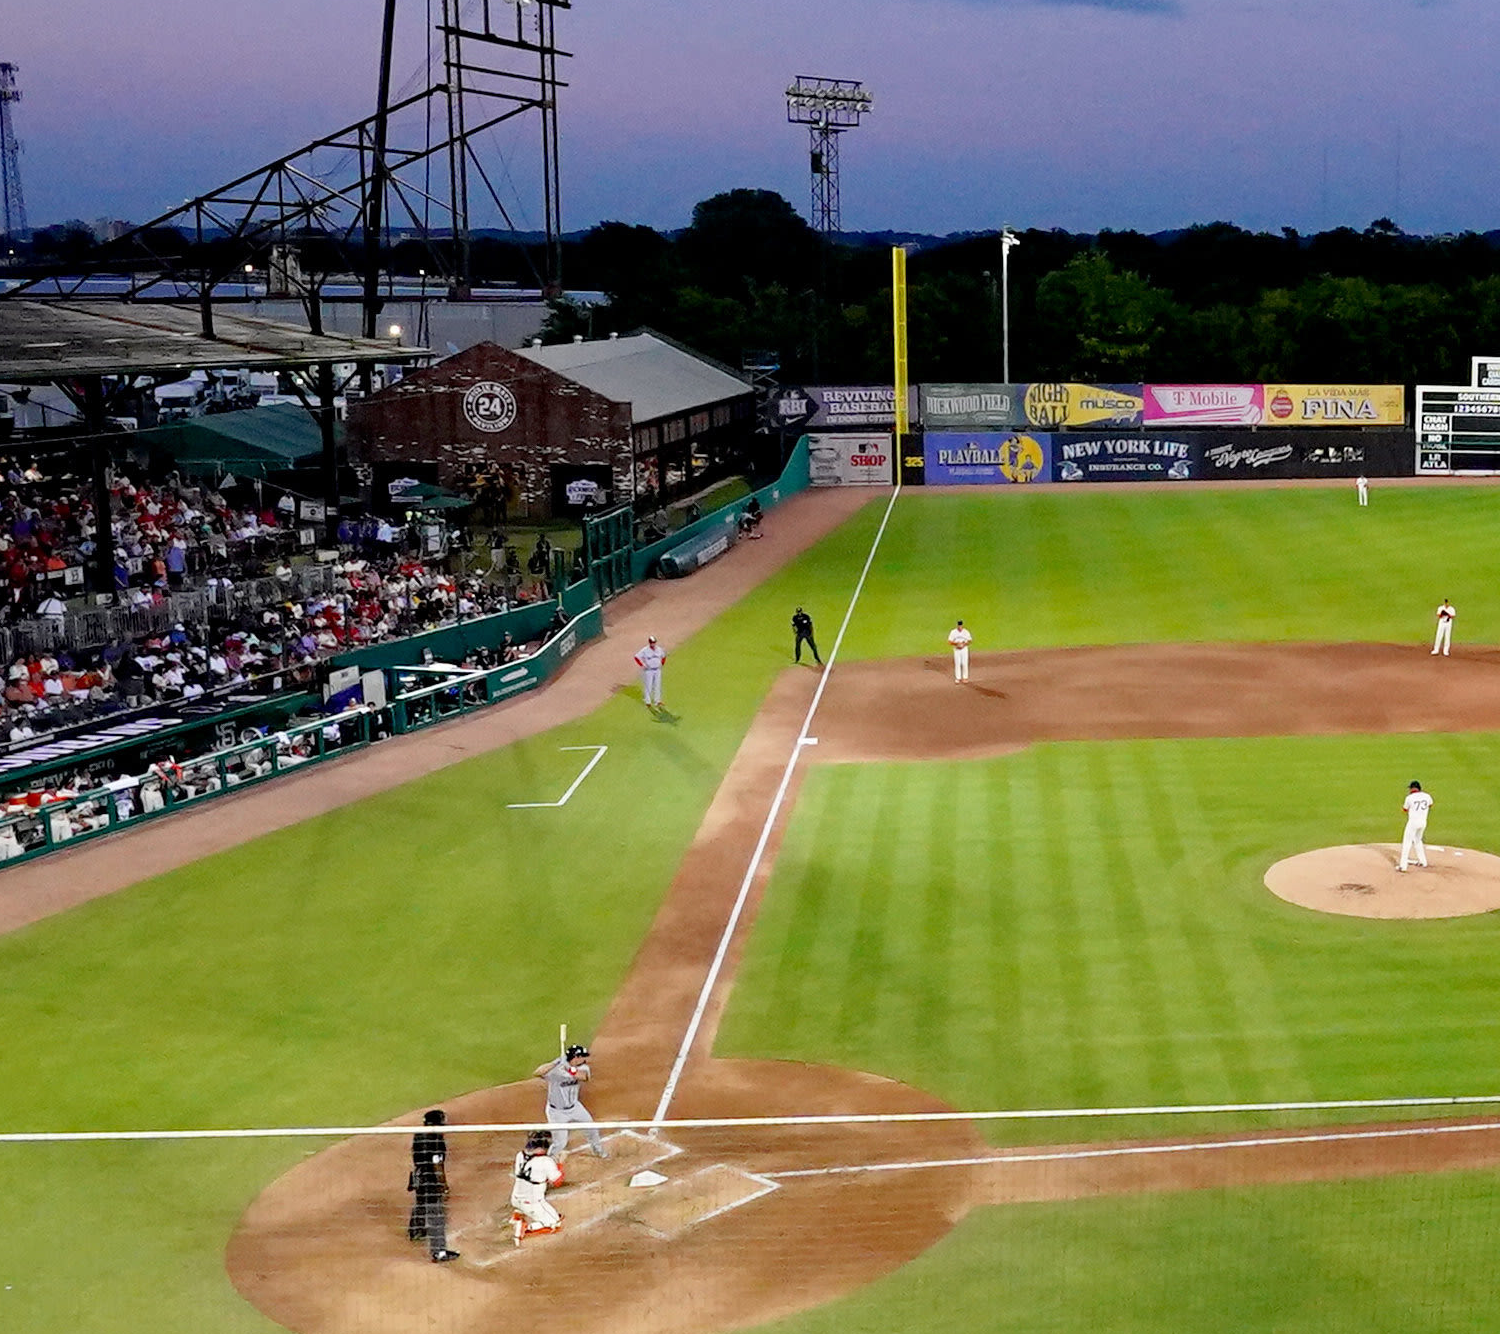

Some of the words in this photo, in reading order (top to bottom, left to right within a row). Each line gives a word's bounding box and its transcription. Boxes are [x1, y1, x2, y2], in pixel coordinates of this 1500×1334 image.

[1189, 390, 1237, 405] Mobile
[1307, 388, 1321, 396] LA
[478, 397, 503, 416] 24
[779, 399, 808, 415] RBI
[829, 402, 896, 414] BASEBAL
[980, 394, 1010, 412] FIELD
[1302, 398, 1378, 420] FINA
[1029, 403, 1070, 424] BALL
[1063, 441, 1101, 460] NEW
[1104, 439, 1150, 455] YORK
[1152, 441, 1189, 458] LIFE
[851, 455, 886, 466] SHOP
[905, 456, 924, 467] 325
[1088, 463, 1146, 471] INSURANCE
[1147, 463, 1164, 471] CO.
[1422, 461, 1448, 469] ATLA
[1413, 799, 1428, 812] 73
